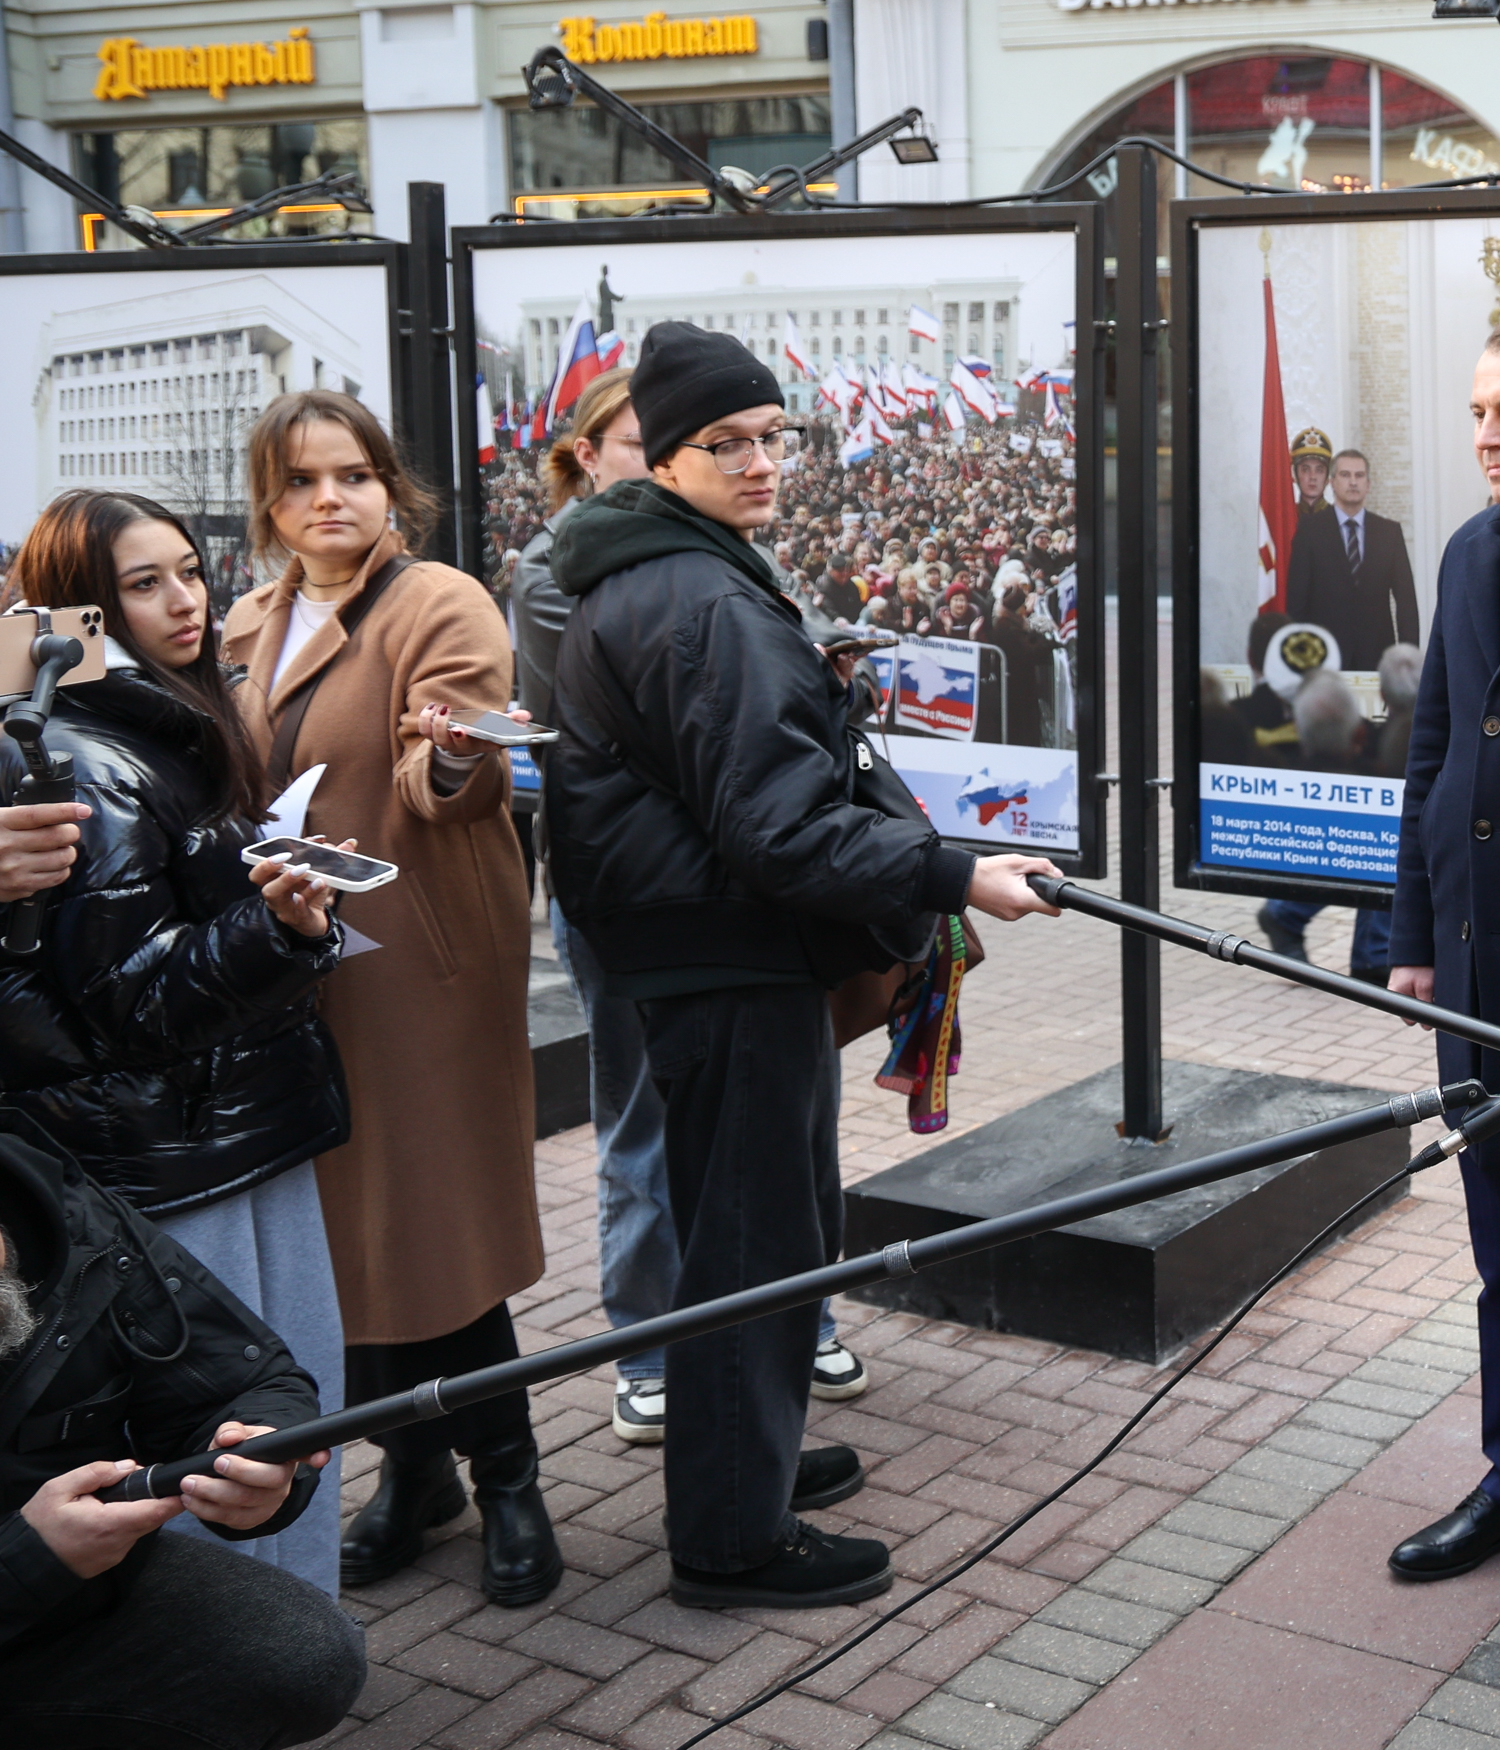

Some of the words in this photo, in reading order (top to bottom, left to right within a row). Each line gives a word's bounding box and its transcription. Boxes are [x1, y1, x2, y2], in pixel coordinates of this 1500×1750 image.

[561, 11, 757, 64] Комбинат
[92, 26, 315, 101] Янтарный
[1211, 774, 1277, 796] КРЫМ
[1300, 782, 1322, 800] 12
[1328, 784, 1373, 804] ЛЕТ
[1381, 789, 1395, 807] В
[1011, 811, 1028, 826] 12
[1211, 815, 1224, 827] 18
[1226, 818, 1261, 831] марта
[1263, 820, 1292, 833] 2014
[1294, 824, 1327, 839] года,
[1328, 826, 1378, 844] Москва,
[1380, 831, 1400, 846] Кр
[1030, 830, 1058, 840] ВЕСНА
[1211, 831, 1251, 846] между
[1252, 833, 1325, 852] Российской
[1211, 844, 1282, 860] Республики
[1283, 851, 1319, 866] Крым
[1321, 856, 1330, 867] и
